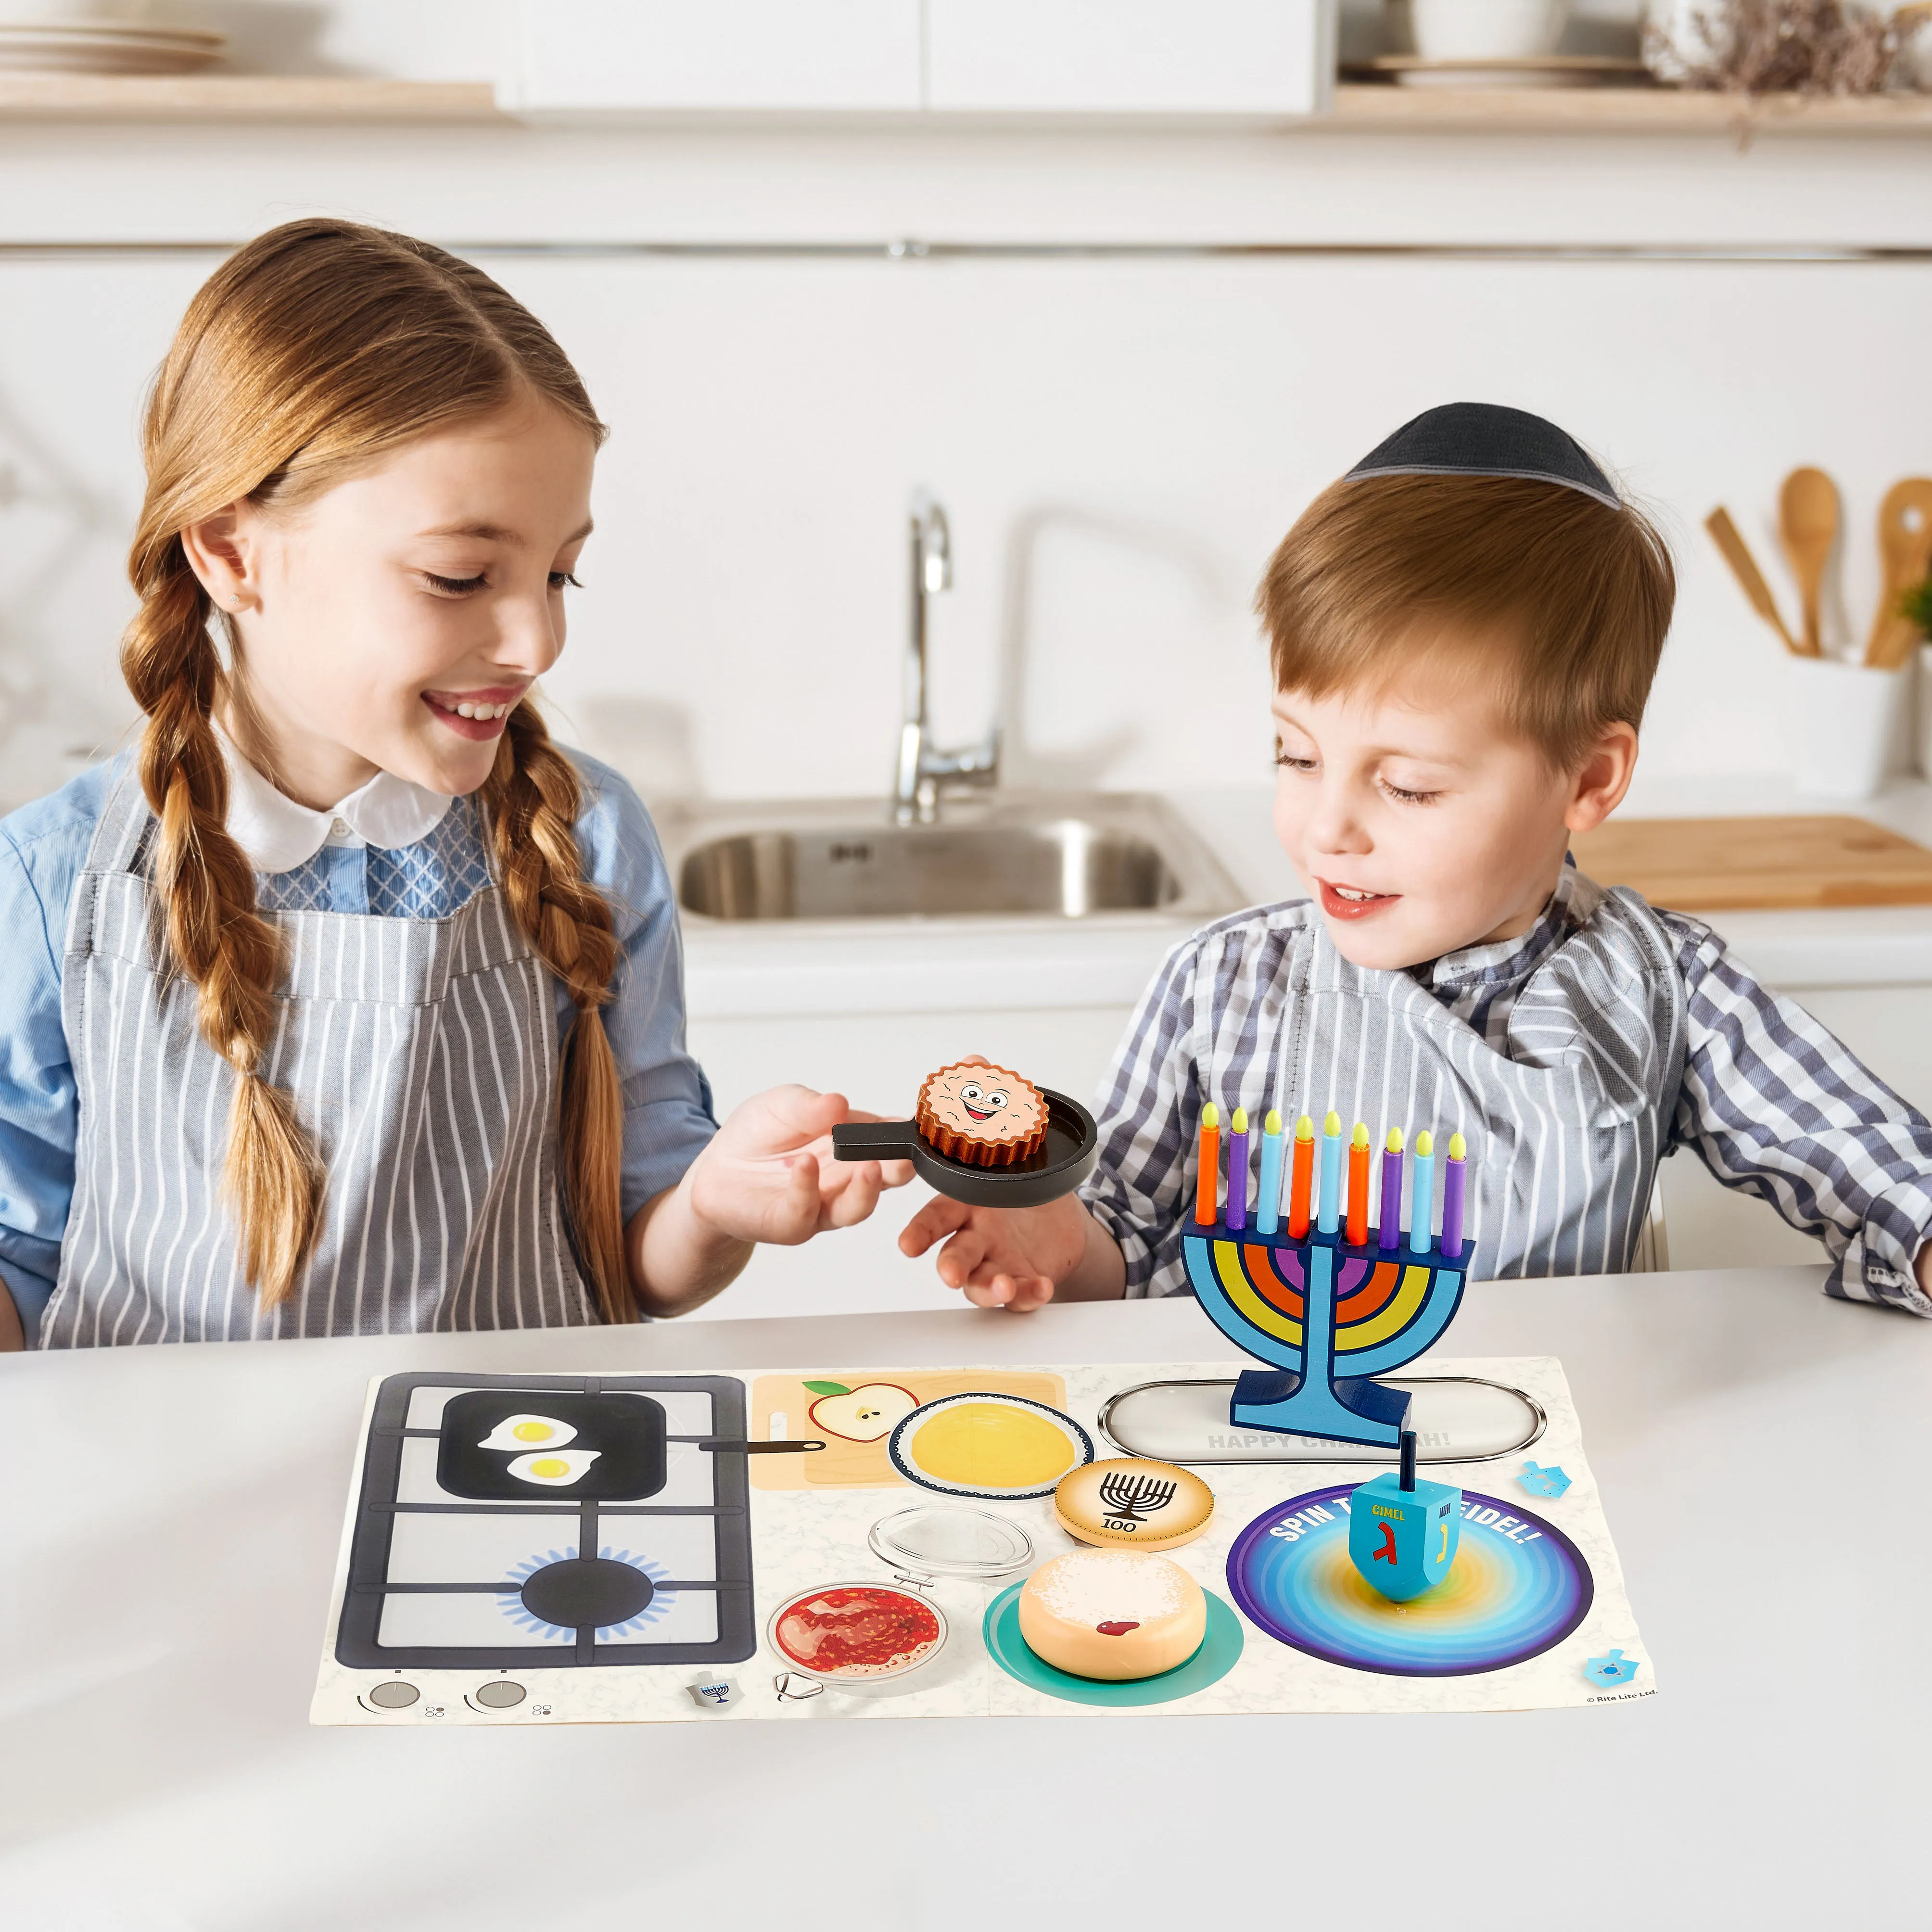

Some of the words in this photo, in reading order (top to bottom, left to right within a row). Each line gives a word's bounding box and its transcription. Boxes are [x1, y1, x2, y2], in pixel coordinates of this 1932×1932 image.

[1208, 1435, 1291, 1448] HAPPY
[1372, 1504, 1405, 1521] GIMEL
[1439, 1502, 1451, 1519] NUN
[1101, 1519, 1136, 1532] 100
[1269, 1504, 1336, 1542] SPIN
[1373, 1521, 1398, 1565] ג
[1436, 1523, 1448, 1564] נ
